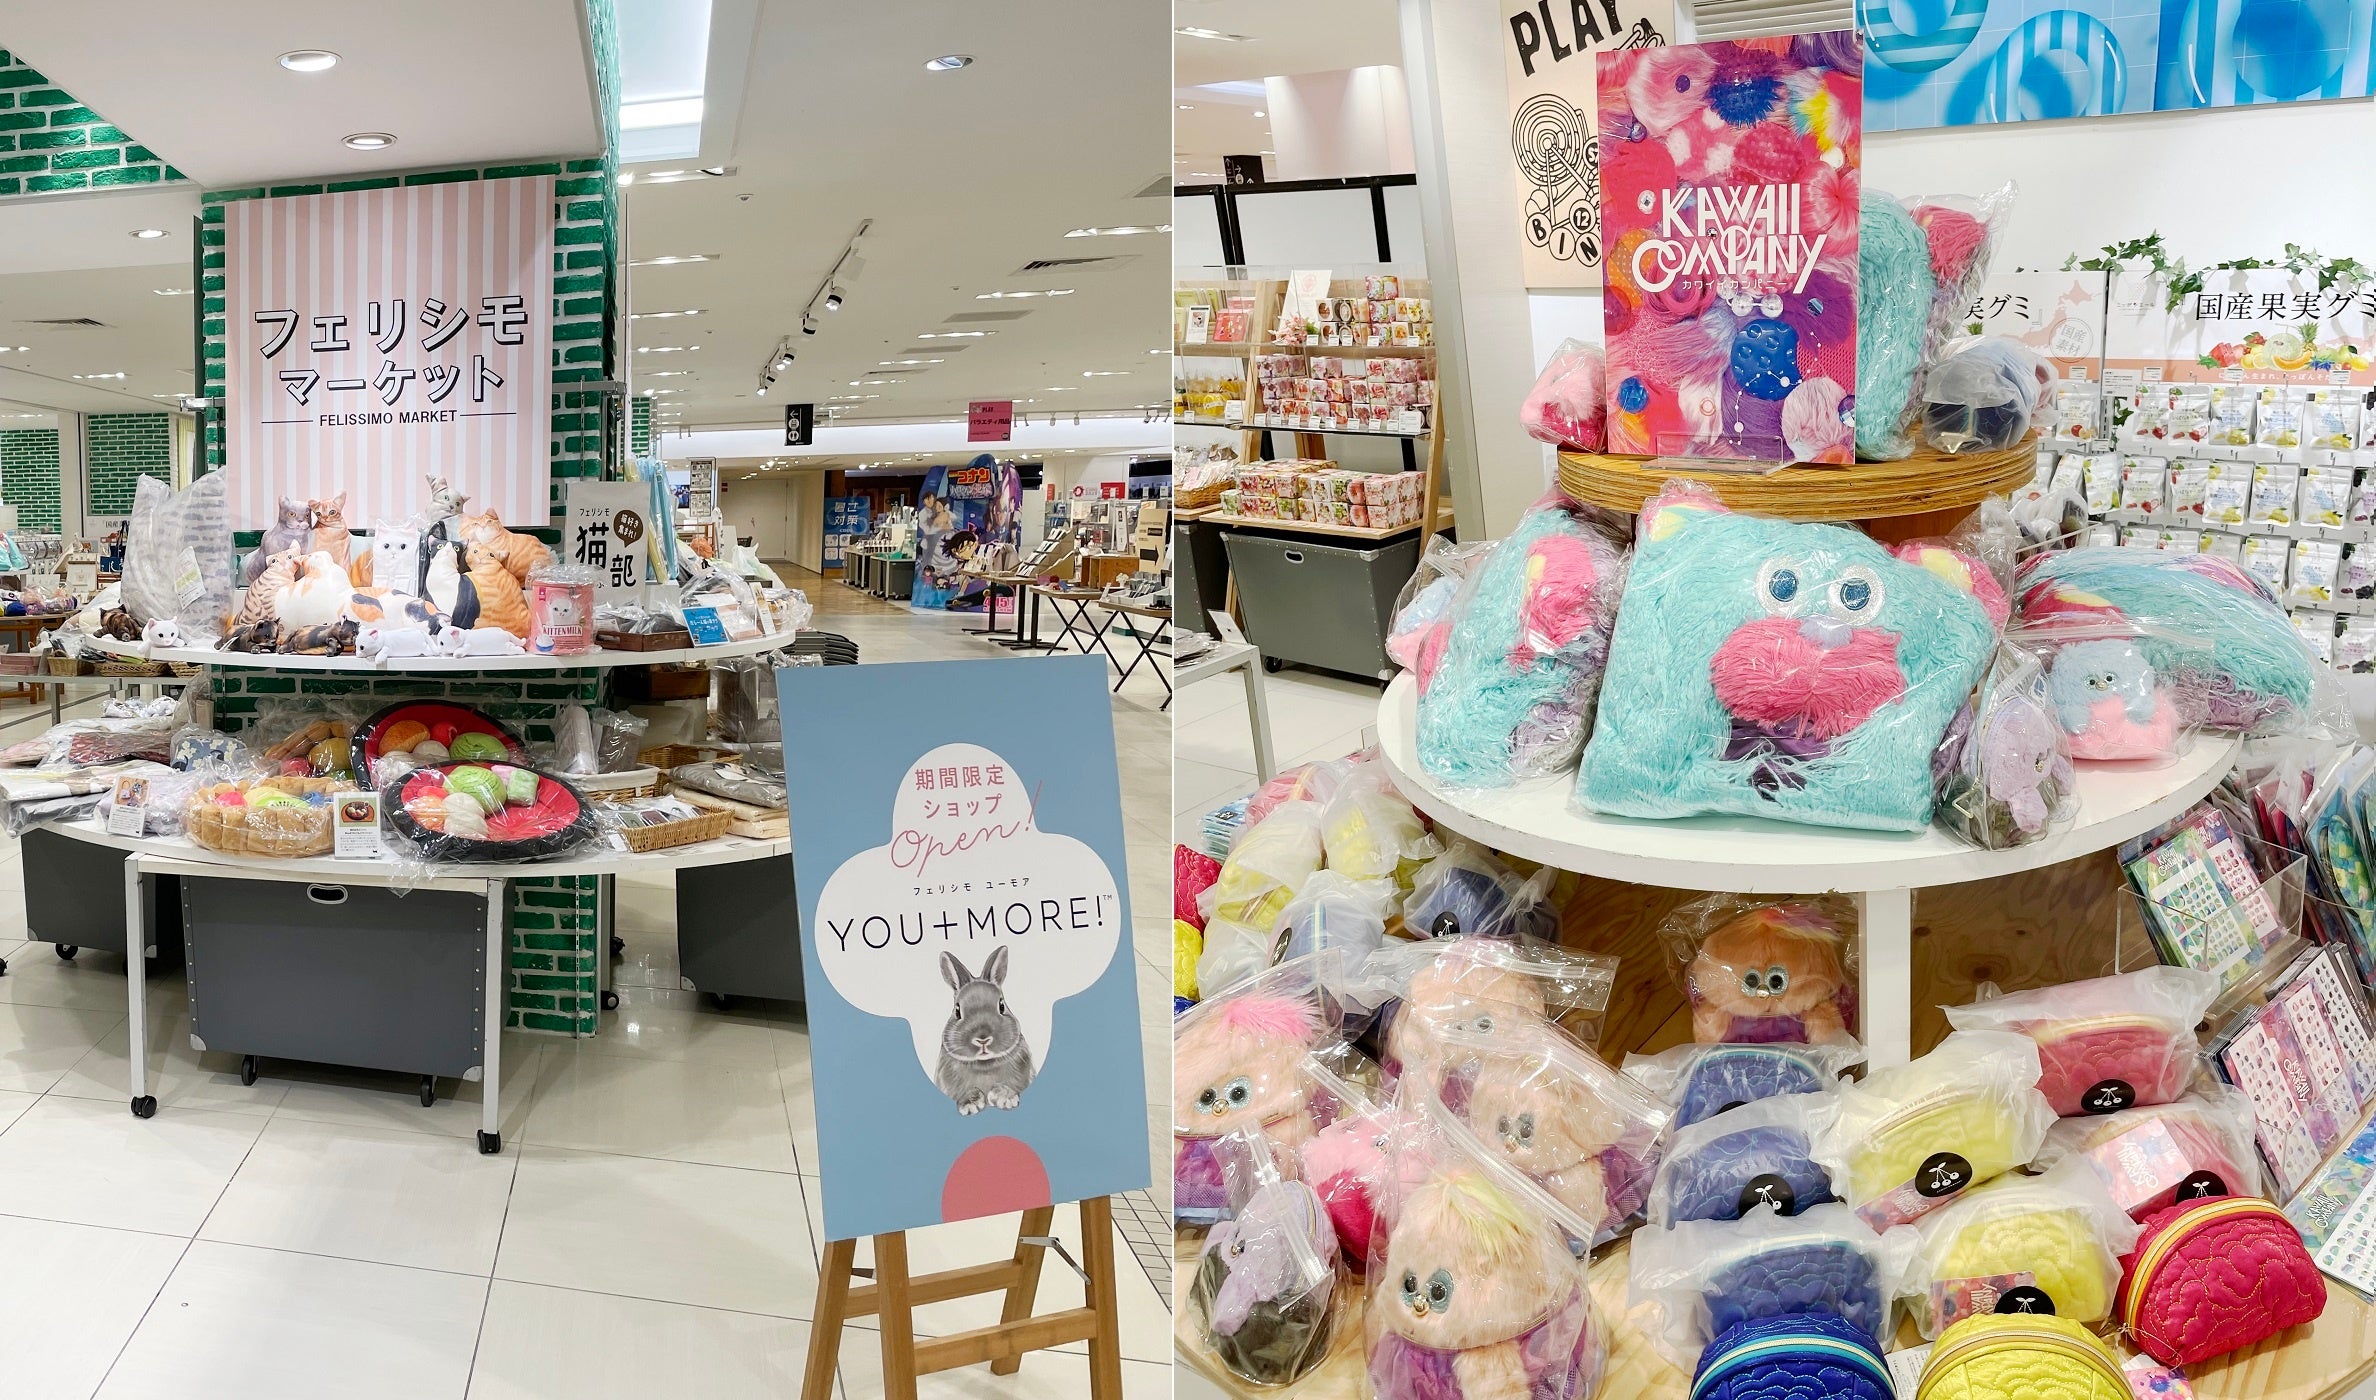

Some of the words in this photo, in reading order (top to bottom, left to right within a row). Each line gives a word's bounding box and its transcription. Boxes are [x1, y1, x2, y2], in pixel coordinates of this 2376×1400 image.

[1510, 0, 1623, 77] PLAY
[1574, 209, 1590, 227] 12
[1662, 183, 1800, 238] KAWAII
[1632, 226, 1828, 294] COMPANY
[1682, 279, 1787, 290] カワイイカンパニー
[255, 295, 528, 359] フェリシモ
[279, 355, 504, 406] マーケット
[319, 412, 393, 427] FELISSIMO
[399, 410, 457, 424] MARKET
[579, 508, 610, 517] フェリシモ
[915, 764, 1005, 791] 期間限定
[923, 793, 1002, 819] ショップ
[891, 780, 1043, 878] Open!
[913, 882, 972, 896] フェリシモ
[986, 877, 1030, 890] ユーモア
[827, 895, 1103, 952] YOU+MORE!
